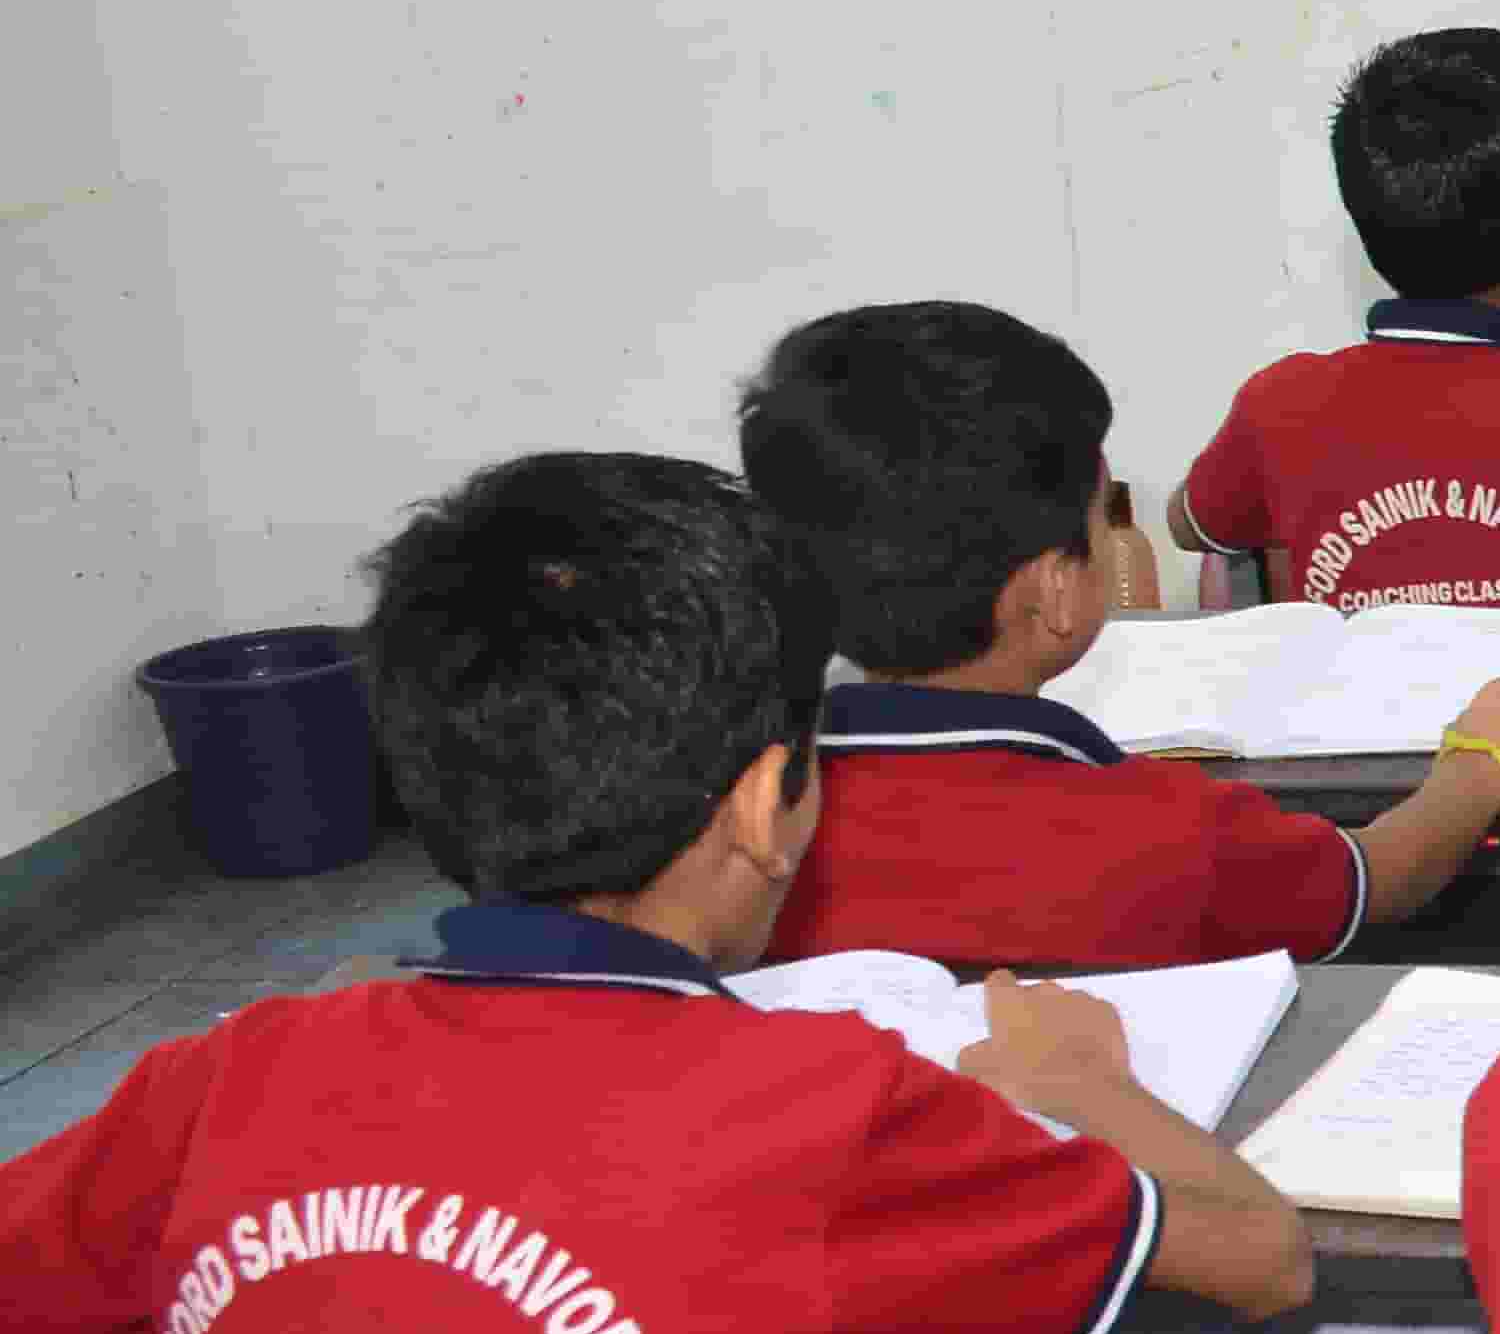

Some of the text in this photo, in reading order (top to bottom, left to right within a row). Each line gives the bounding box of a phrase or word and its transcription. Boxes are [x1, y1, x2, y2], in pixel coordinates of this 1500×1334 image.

[1339, 478, 1440, 546] SAINIK
[1446, 479, 1465, 518] &
[1339, 581, 1451, 612] COACHING
[230, 1185, 424, 1281] SAINIK
[417, 1195, 464, 1261] &
